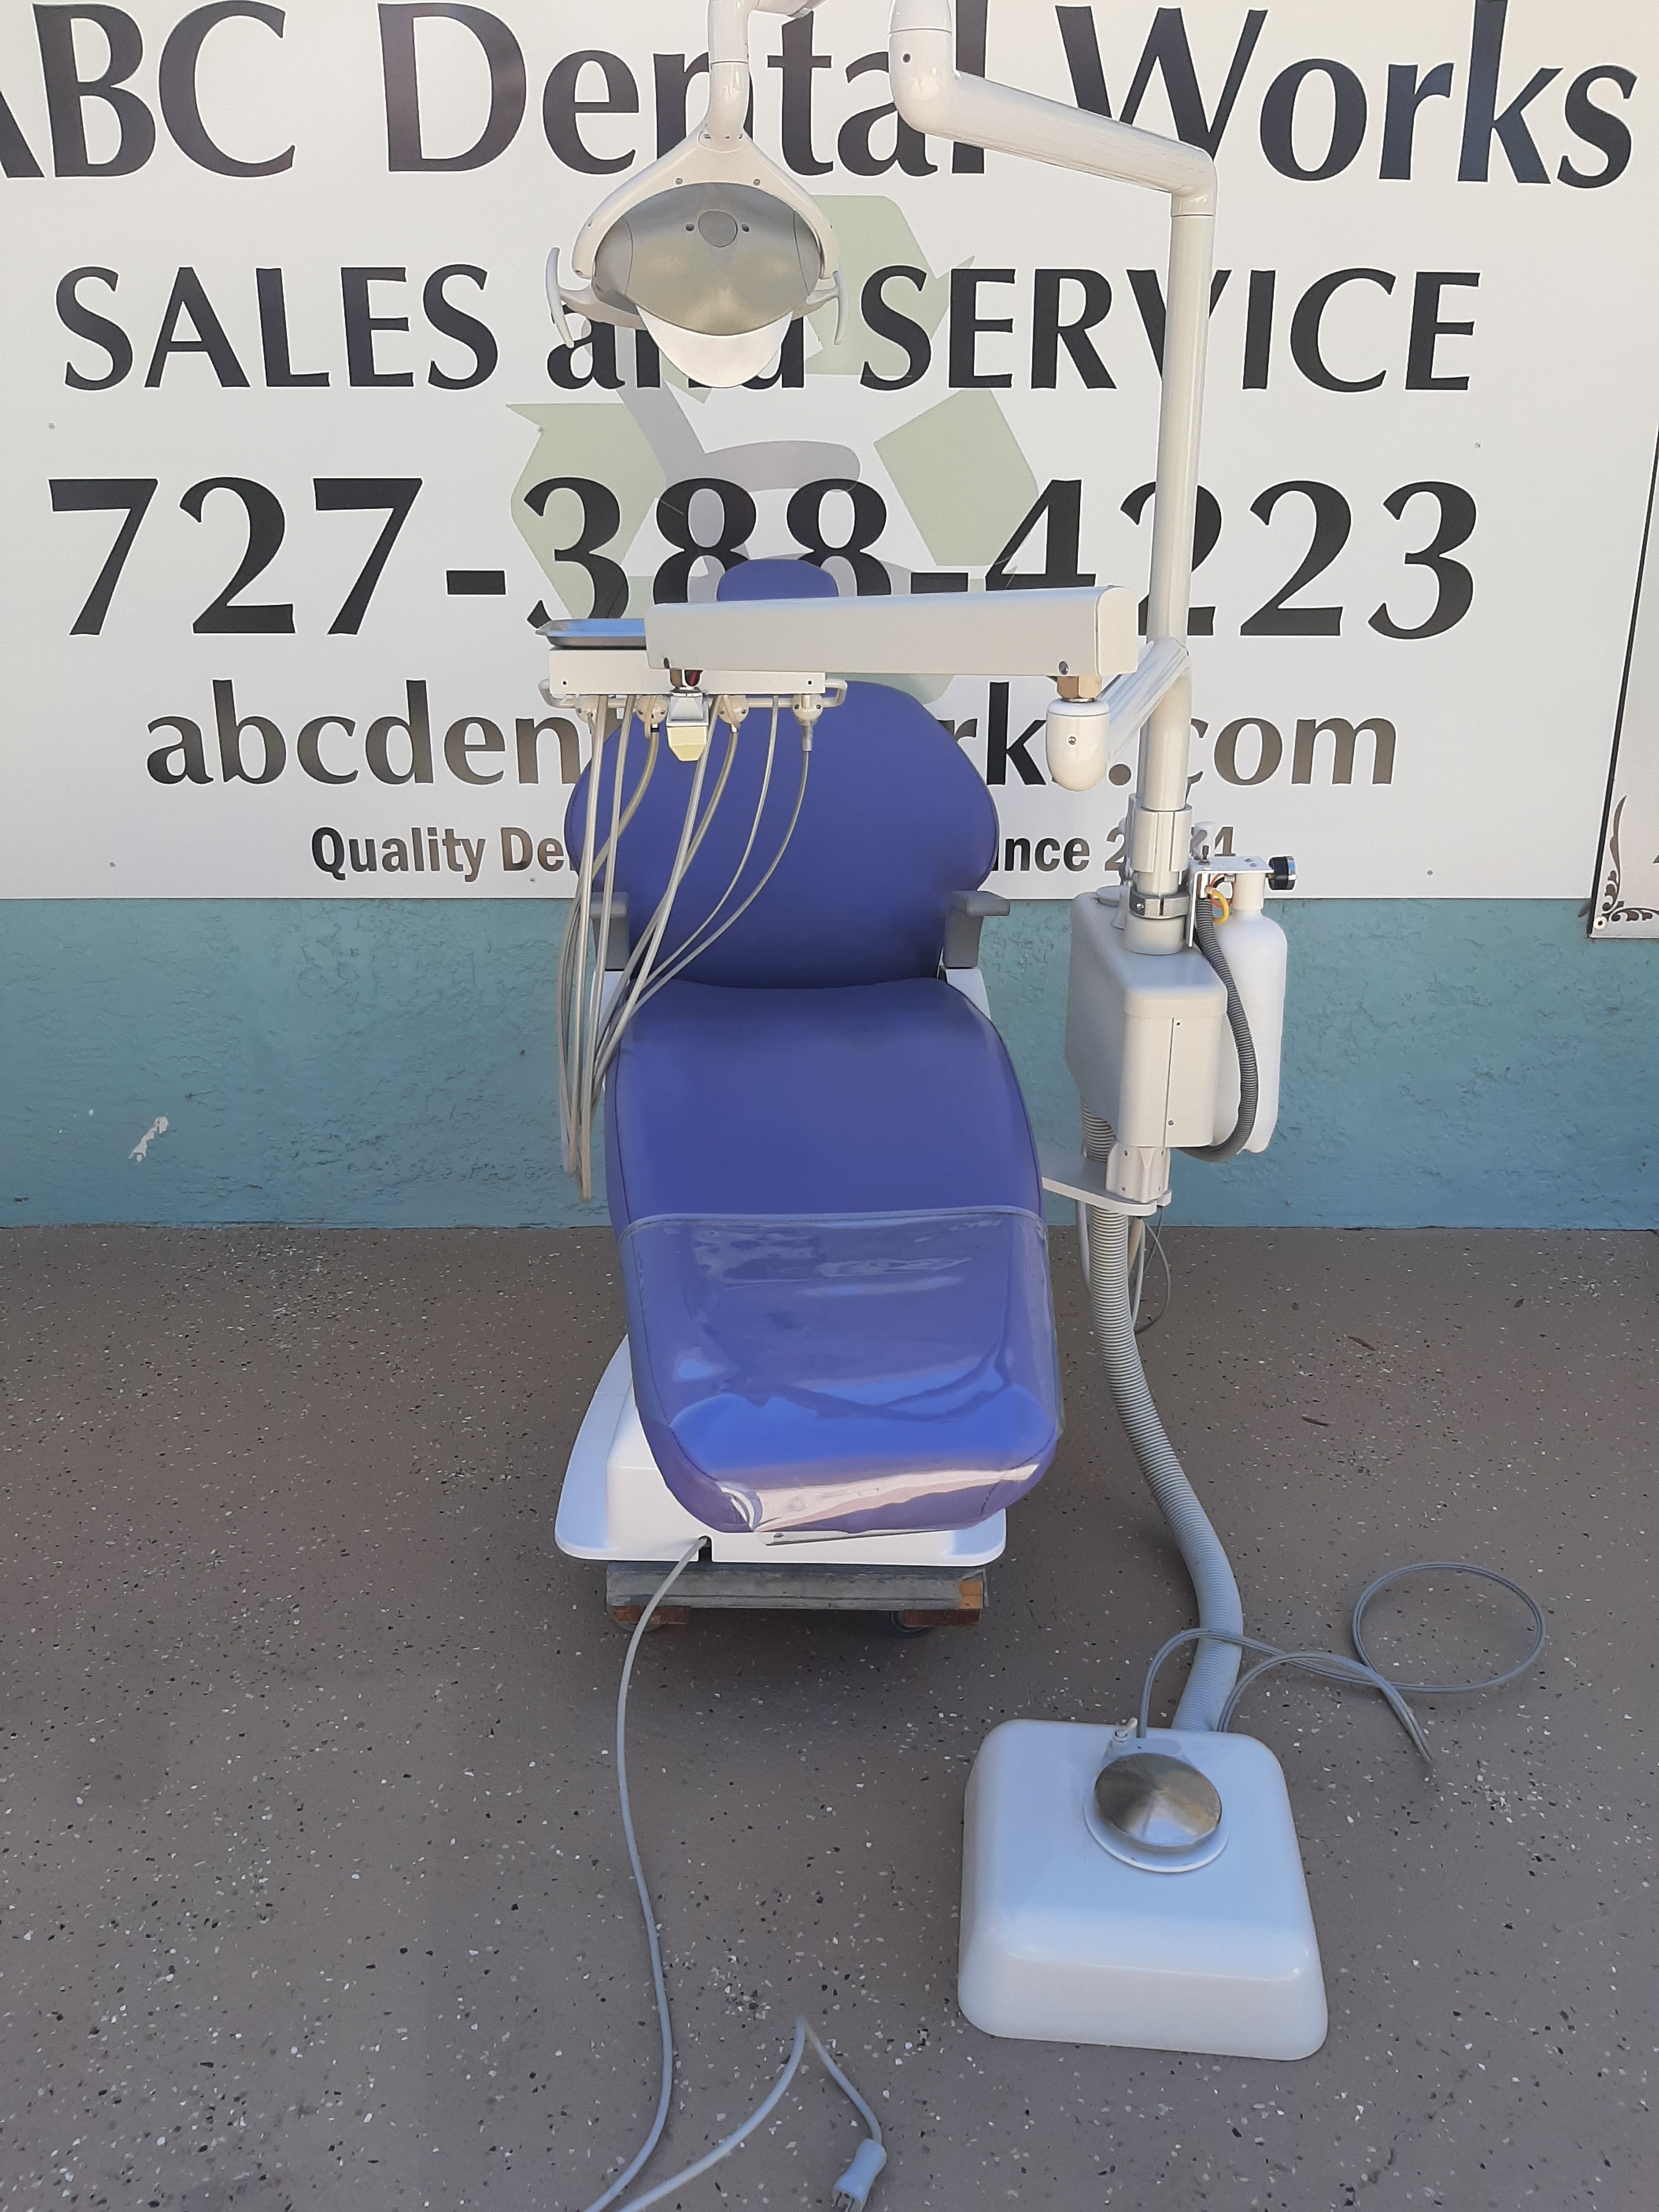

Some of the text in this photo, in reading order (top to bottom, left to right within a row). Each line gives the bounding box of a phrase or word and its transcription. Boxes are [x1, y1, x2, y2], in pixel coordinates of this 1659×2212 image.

[1055, 0, 1637, 188] Works
[56, 264, 498, 391] SALES
[860, 265, 1481, 393] SERVICE
[48, 477, 1477, 640] 727-388-4223
[312, 827, 486, 882] Quality
[992, 837, 1090, 872] nce
